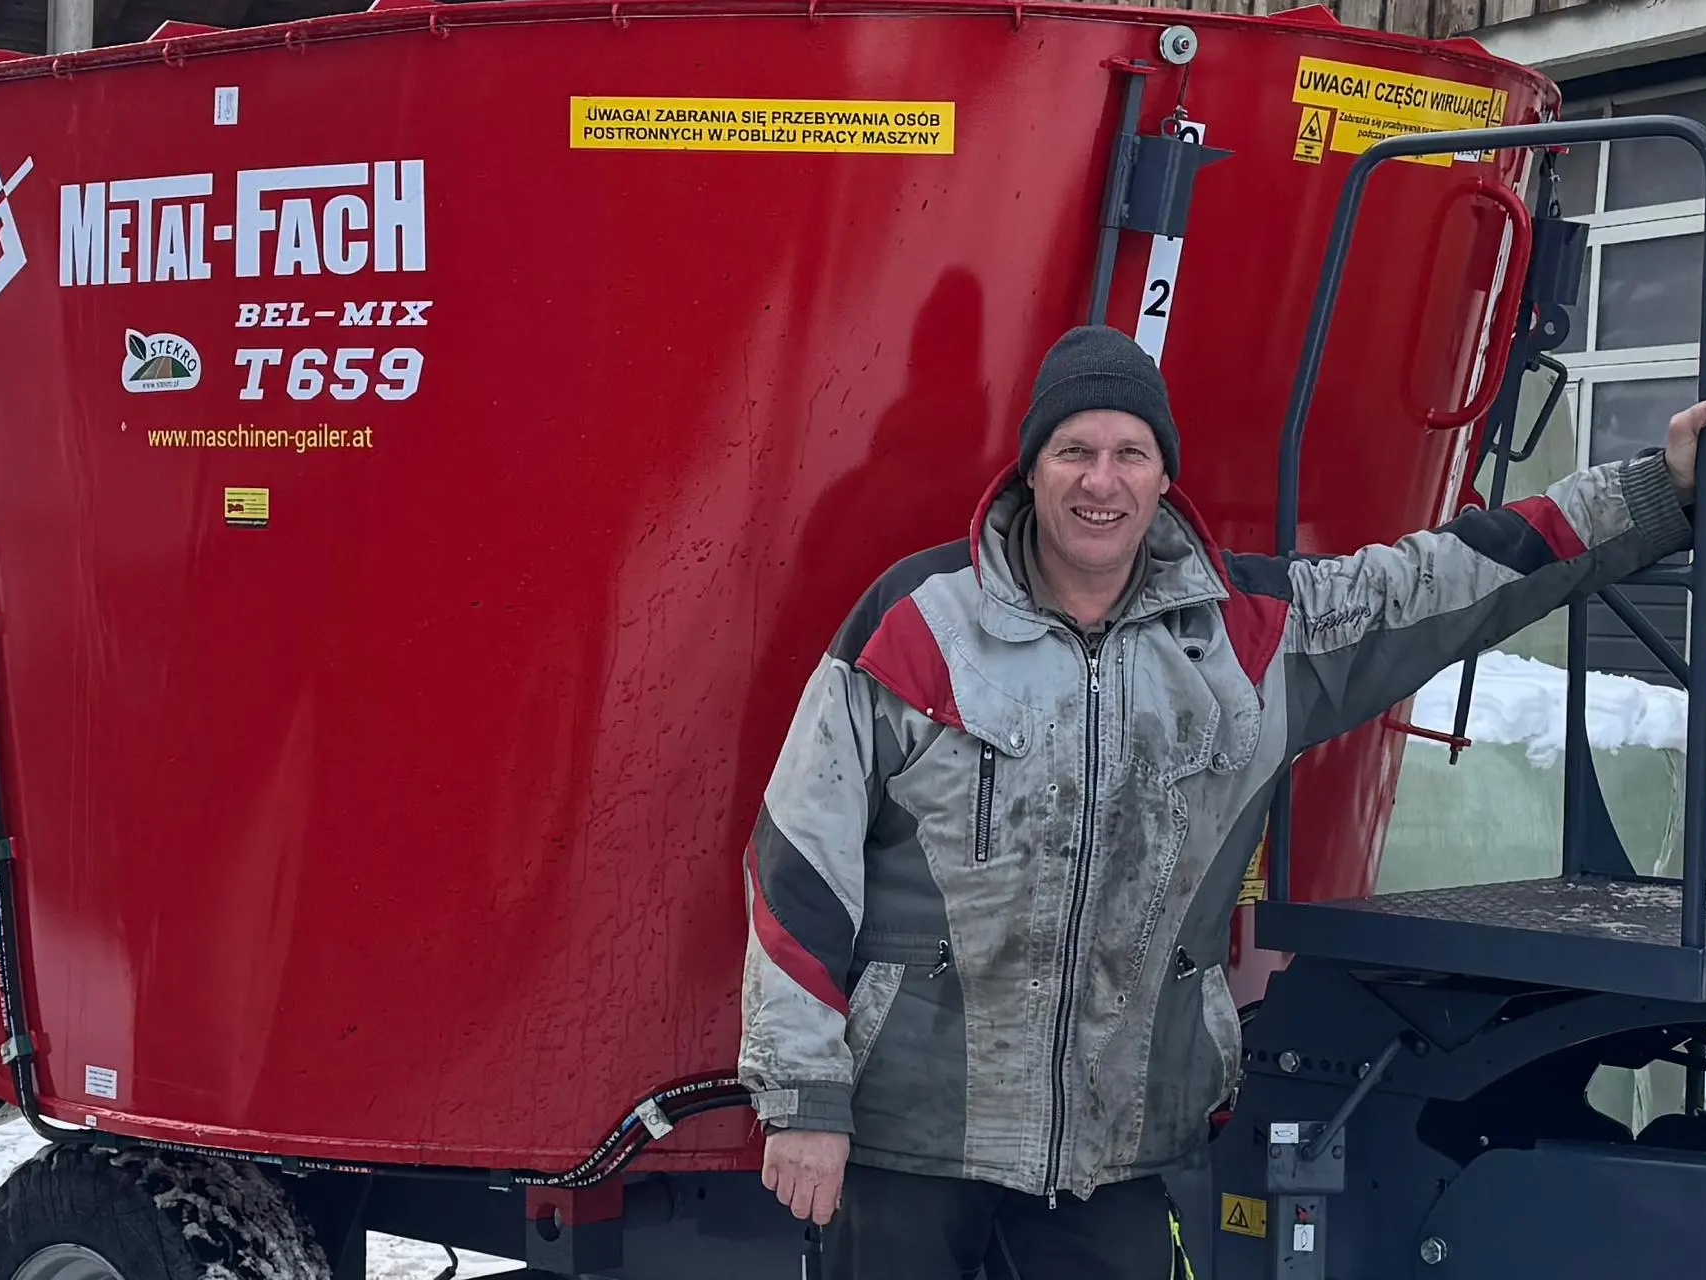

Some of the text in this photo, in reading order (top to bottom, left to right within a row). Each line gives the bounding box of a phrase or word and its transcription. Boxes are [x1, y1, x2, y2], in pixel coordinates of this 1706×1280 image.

[1299, 70, 1489, 122] UWAGA! CZĘŚCI WIRUJĄCE
[585, 109, 941, 127] UWAGA! ZABRANIA SIĘ PRZEBYWANIA OSÓB
[583, 126, 940, 145] POSTRONNYCH W POBLIŻU PRACY MASZYNY
[235, 300, 433, 328] BEL-MIX
[1143, 278, 1170, 318] 2
[150, 339, 198, 372] STEKRO
[234, 347, 425, 401] T659
[147, 423, 374, 454] www.maschinen-gailer.at
